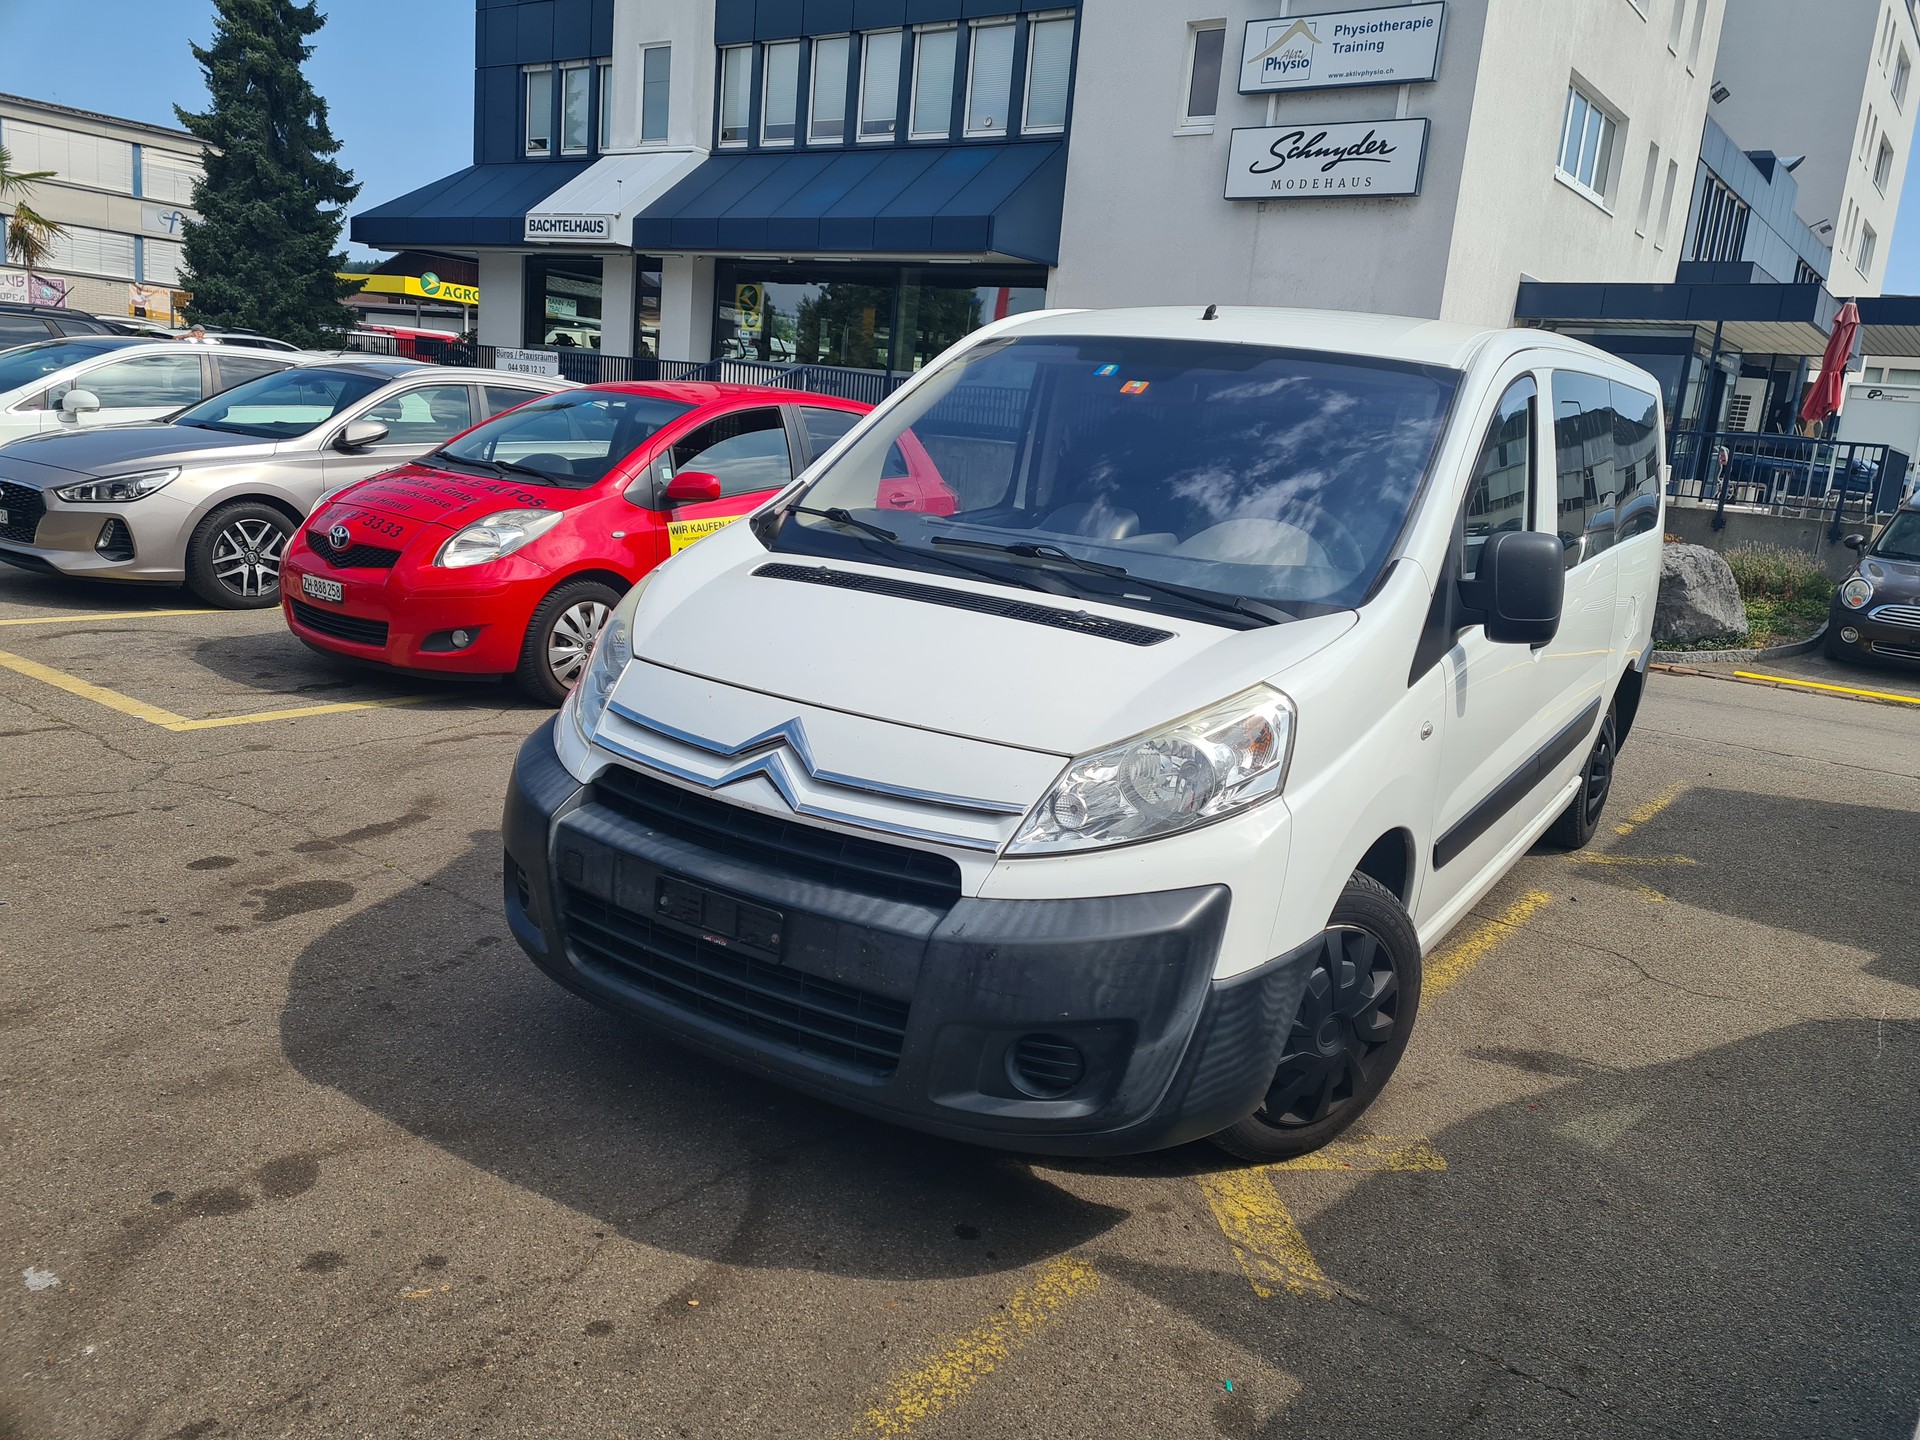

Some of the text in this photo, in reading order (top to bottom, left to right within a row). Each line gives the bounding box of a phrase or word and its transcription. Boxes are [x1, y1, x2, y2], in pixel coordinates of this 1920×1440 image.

[1334, 17, 1433, 37] Physiotherapie
[1332, 40, 1384, 54] Training
[1280, 48, 1308, 61] Aktiv
[1265, 56, 1309, 74] Physio
[1328, 68, 1394, 79] www.aktivphysio.ch
[1249, 129, 1397, 174] Schnyder
[1270, 176, 1373, 190] MODEHAUS
[528, 219, 604, 233] BACHTELHAUS
[497, 349, 513, 358] Büros
[520, 351, 557, 363] Praxisräume
[508, 363, 518, 371] 044
[520, 365, 529, 373] 938
[539, 366, 546, 374] 12
[482, 484, 546, 507] AUTOS
[362, 515, 405, 538] 3333
[670, 525, 688, 535] WIR
[691, 521, 725, 533] KAUFEN
